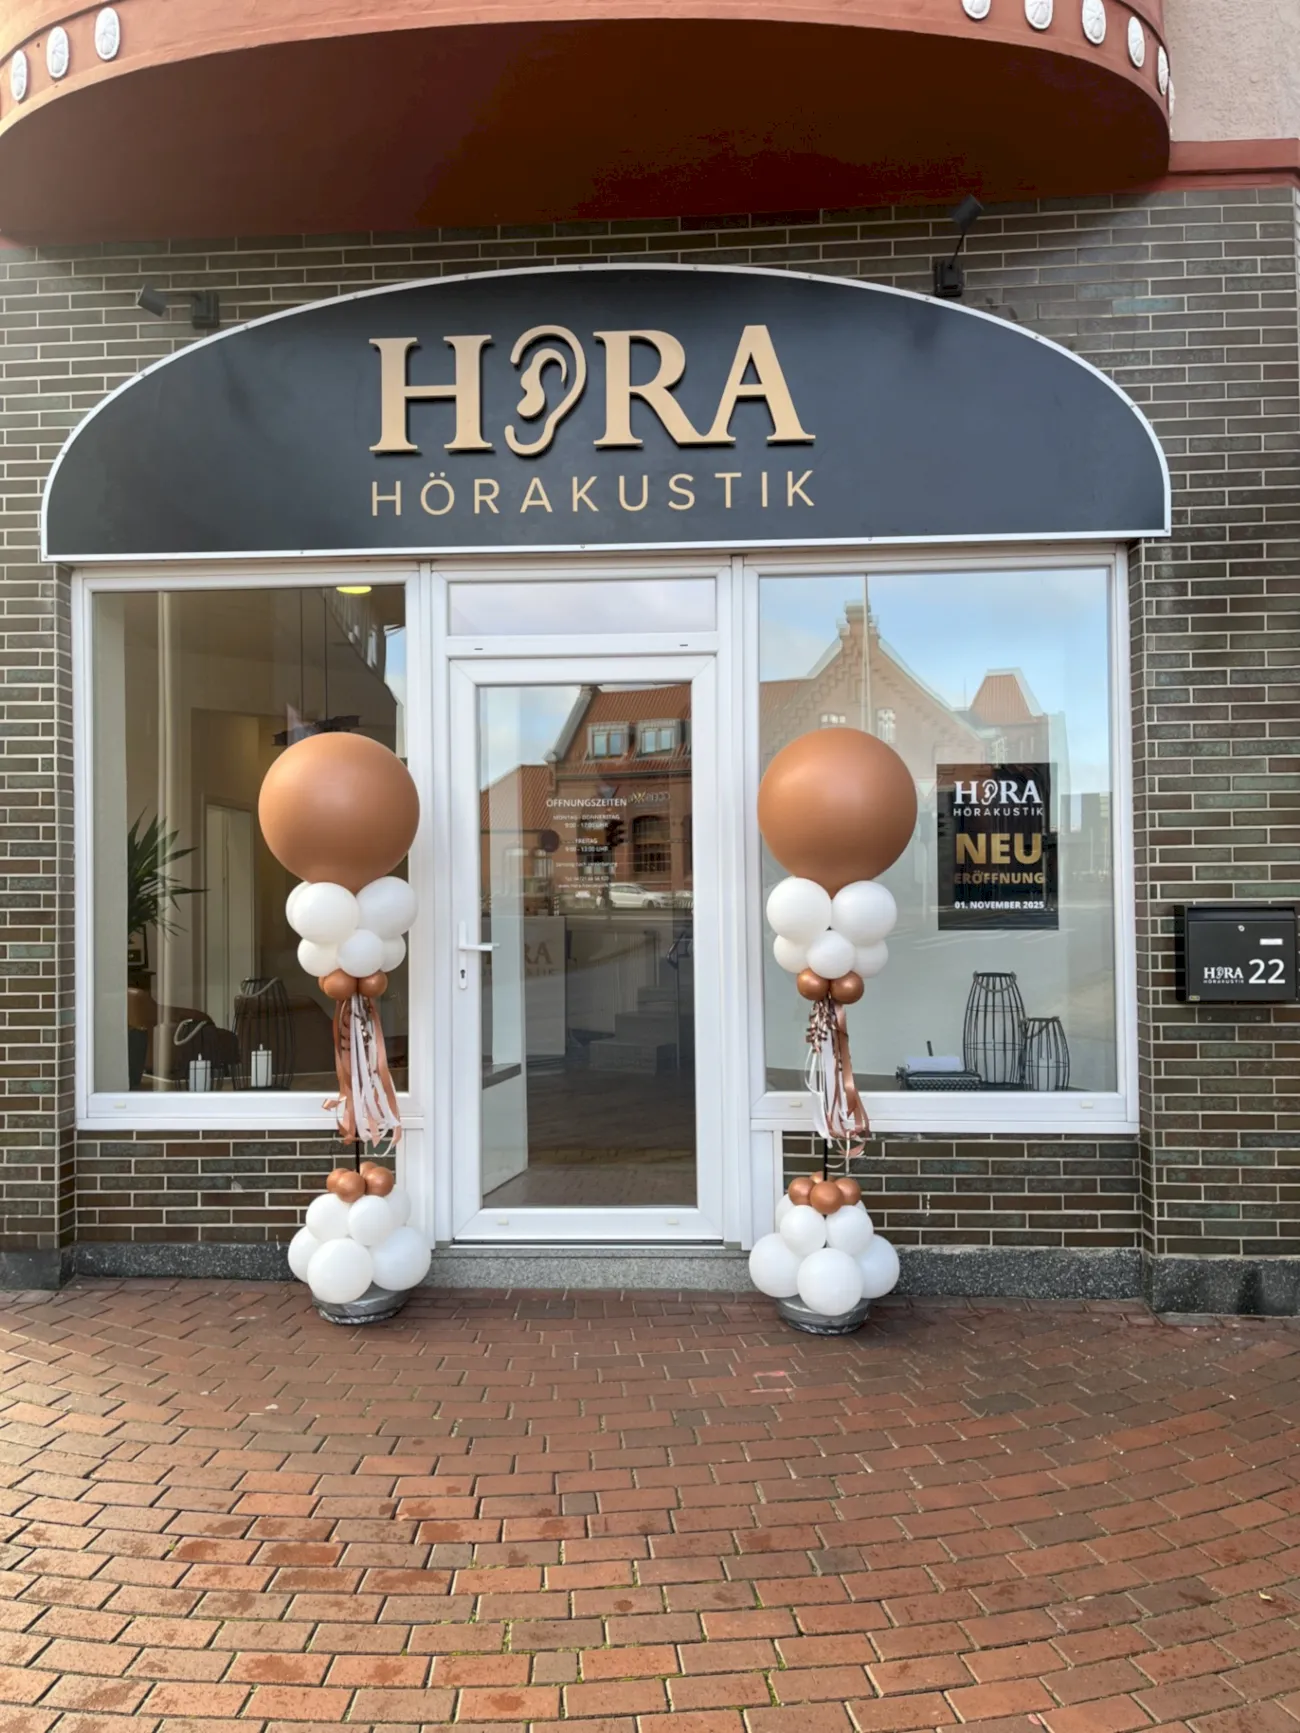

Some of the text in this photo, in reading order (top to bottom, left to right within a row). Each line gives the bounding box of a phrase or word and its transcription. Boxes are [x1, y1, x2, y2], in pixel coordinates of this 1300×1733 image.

[371, 470, 815, 516] HÖRAKUSTIK
[953, 806, 1043, 817] HÖRAKUSTIK
[956, 833, 1042, 864] NEU
[954, 870, 1045, 884] ERÖFFNUNG
[954, 901, 1044, 909] 01. NOVEMBER 2025
[1248, 959, 1286, 984] 22
